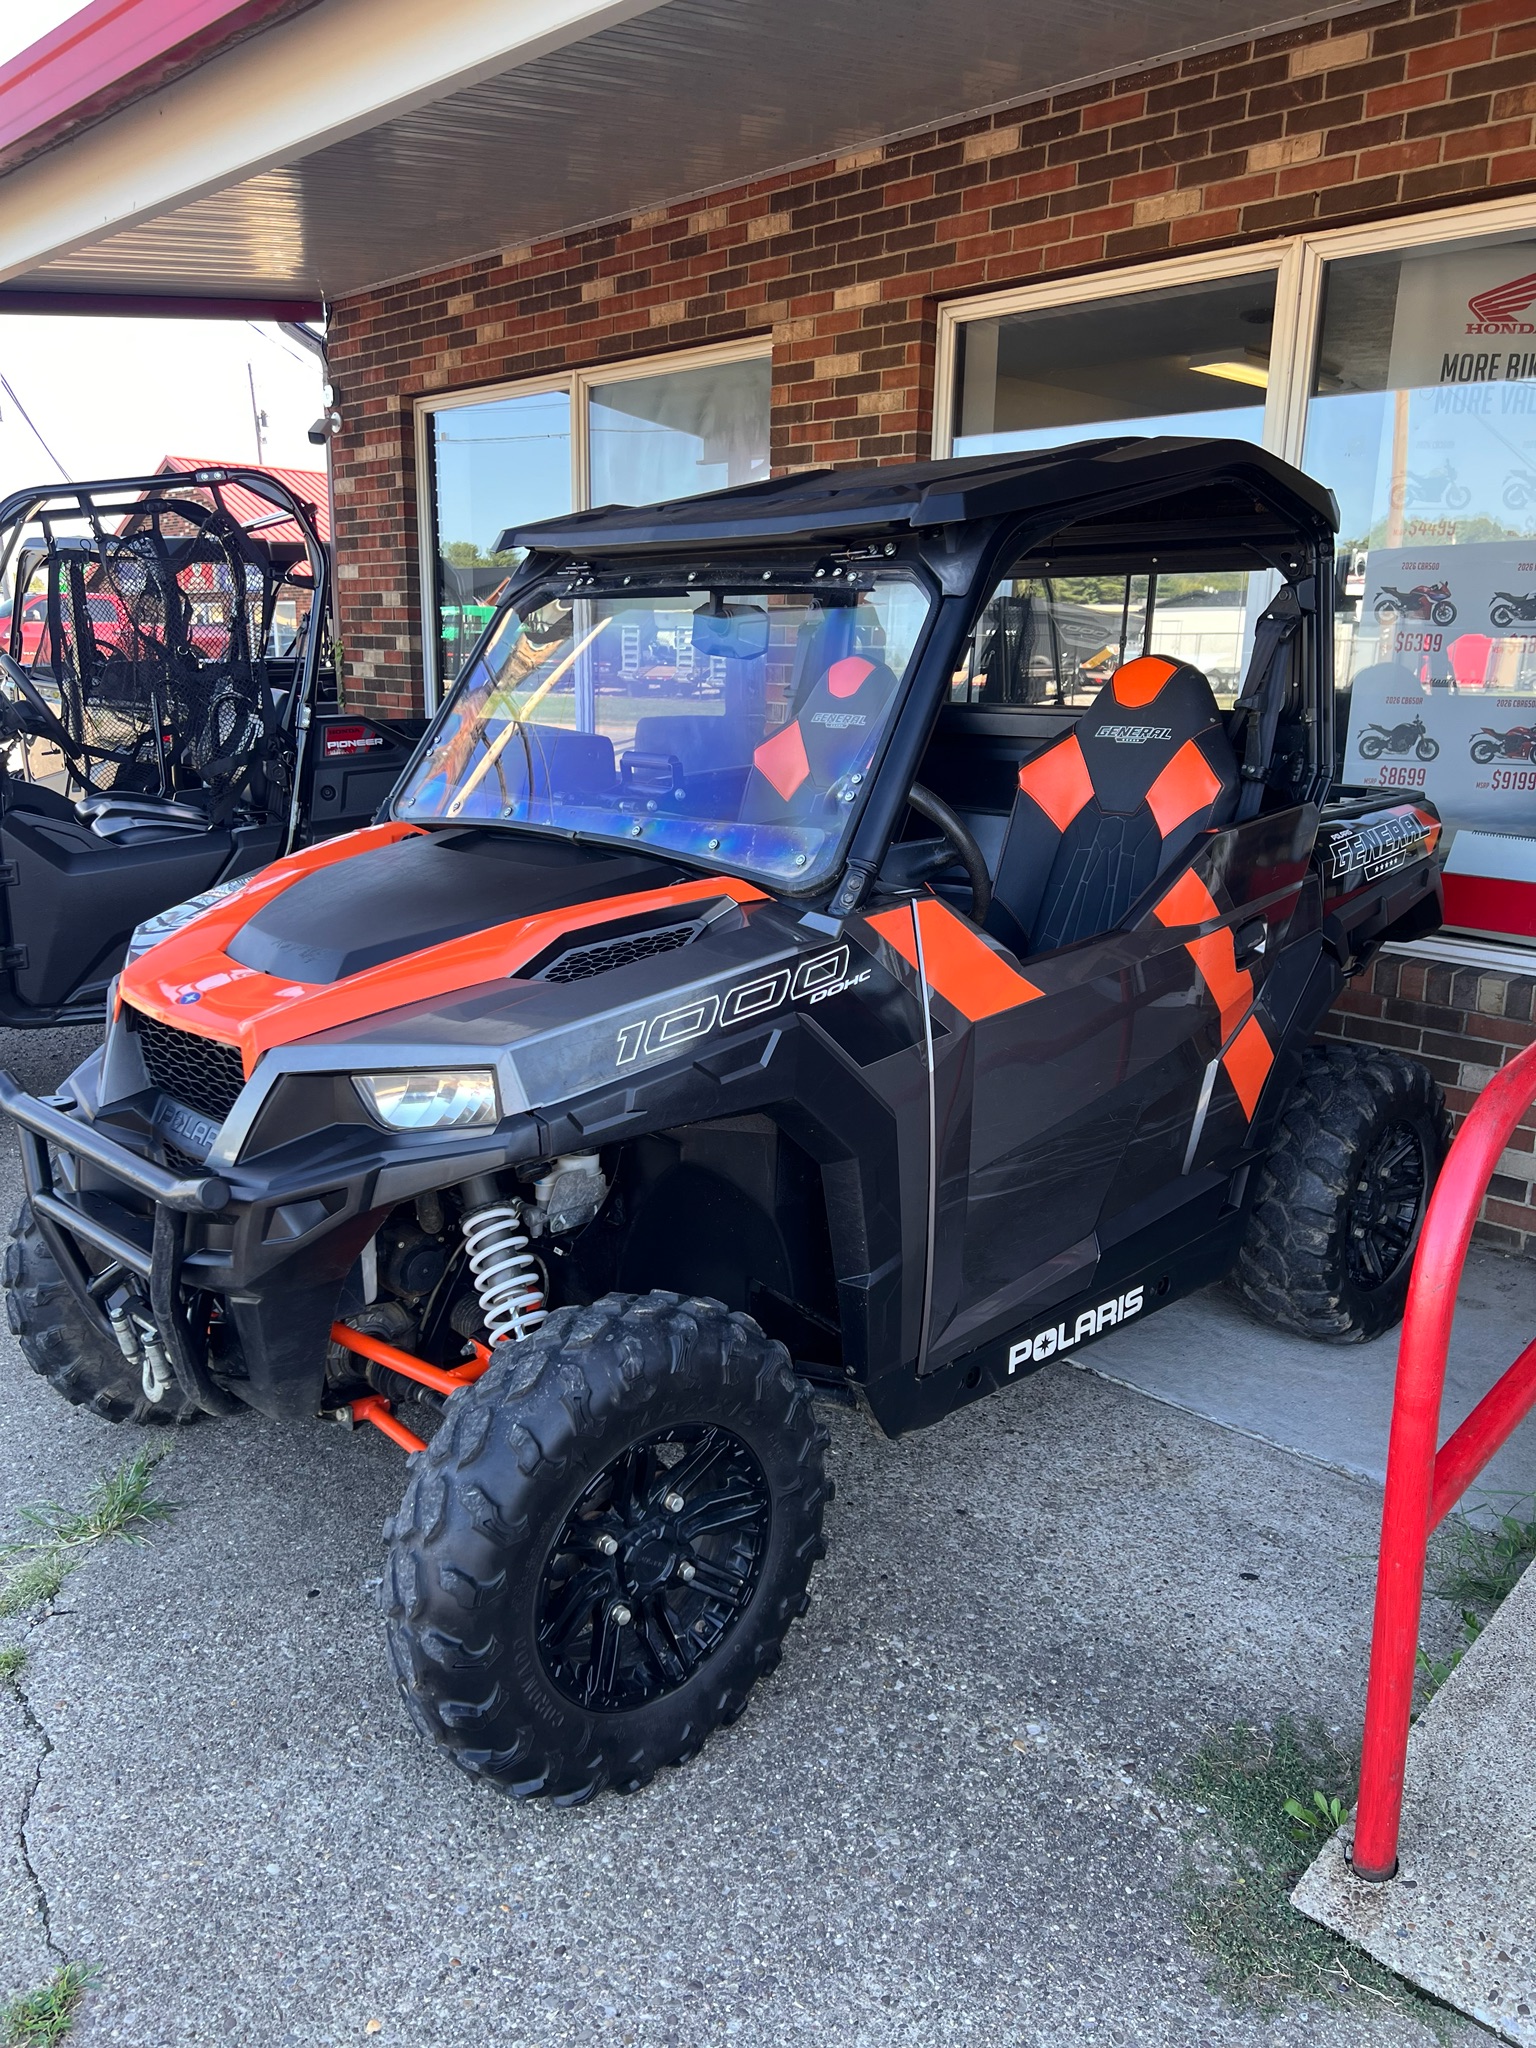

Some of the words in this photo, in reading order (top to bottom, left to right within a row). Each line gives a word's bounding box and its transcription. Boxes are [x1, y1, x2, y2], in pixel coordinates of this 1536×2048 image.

[1465, 323, 1536, 335] HOND
[1440, 353, 1502, 382] MORE
[1434, 385, 1495, 415] MORE
[1408, 519, 1457, 537] $4499
[1401, 562, 1416, 571] 2026
[1394, 631, 1443, 653] $6399
[1385, 696, 1400, 704] 2026
[1401, 697, 1424, 705] CB650R
[1496, 699, 1512, 707] 2026
[811, 712, 867, 726] GENERAL
[327, 738, 383, 749] PIONEER
[1095, 725, 1172, 740] GENERAL
[1363, 777, 1377, 785] MSRP
[1378, 765, 1426, 787] $8699
[1475, 781, 1490, 789] MSRP
[1491, 769, 1536, 791] $9199
[1329, 811, 1431, 879] GENERAL
[809, 968, 872, 1005] DOHC
[616, 944, 850, 1066] 1000
[1008, 1285, 1144, 1375] POLARIS
